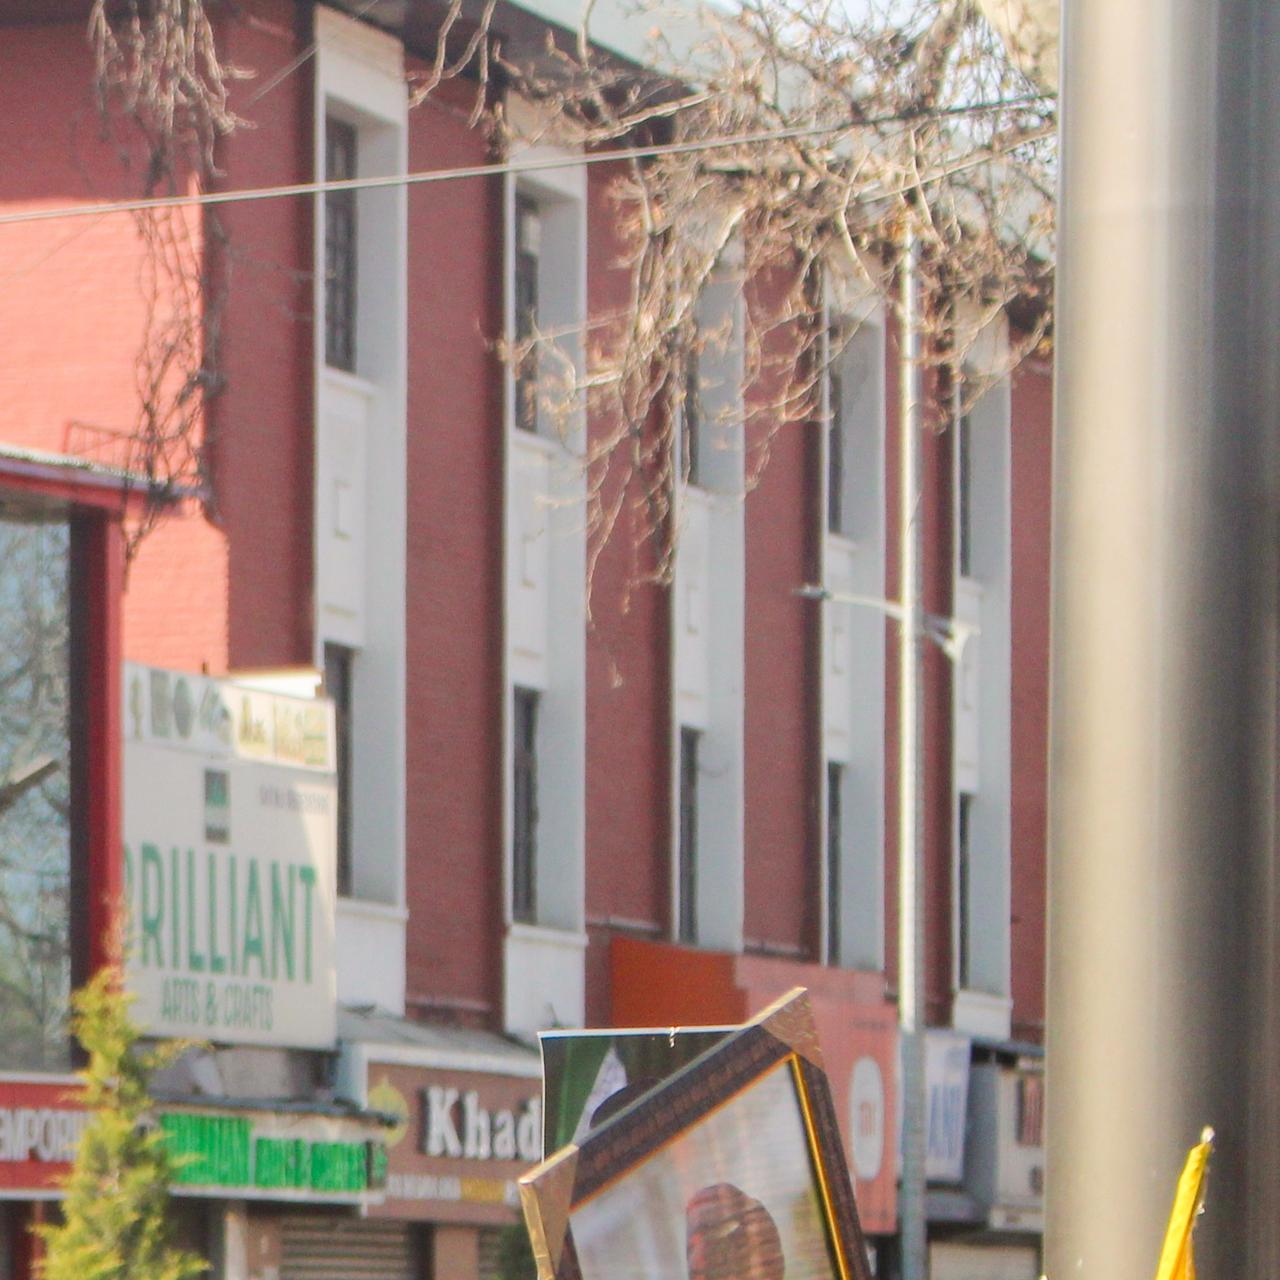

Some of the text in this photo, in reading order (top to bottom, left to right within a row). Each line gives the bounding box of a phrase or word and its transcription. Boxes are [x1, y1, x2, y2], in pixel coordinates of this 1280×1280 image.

[161, 976, 274, 1032] ARTS & CRAFTS
